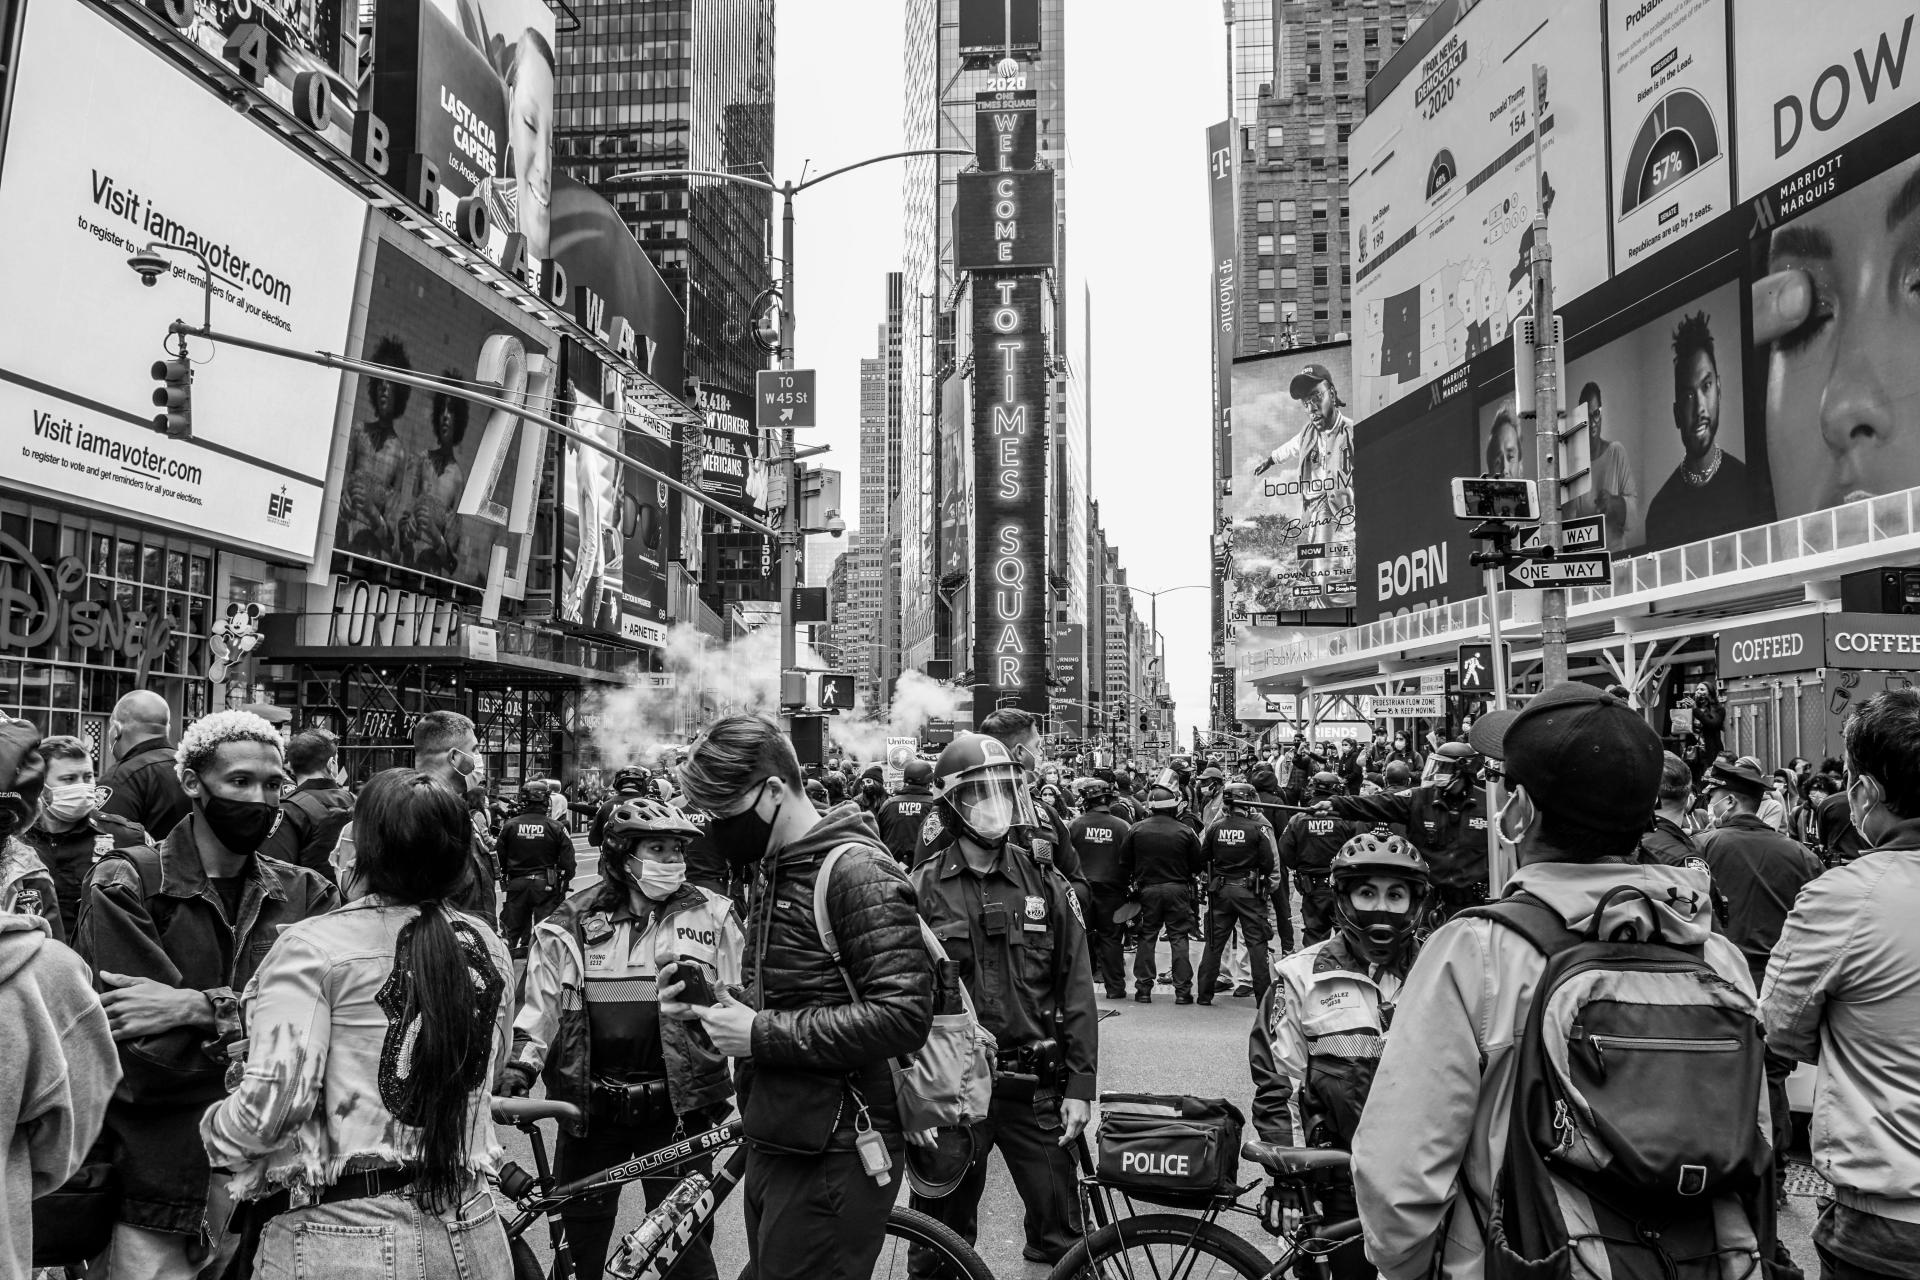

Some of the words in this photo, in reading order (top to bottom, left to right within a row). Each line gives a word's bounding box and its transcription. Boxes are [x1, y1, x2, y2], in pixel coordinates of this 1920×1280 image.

[1426, 53, 1439, 76] FOX
[1439, 33, 1458, 63] NEWS
[987, 77, 1027, 92] 2020
[1417, 45, 1464, 103] DEMOCRACY
[1637, 86, 1654, 103] Biden
[1653, 80, 1660, 91] is
[1659, 75, 1666, 87] in
[1666, 66, 1676, 81] the
[1676, 54, 1694, 74] Lead.
[976, 101, 1001, 110] TIMES
[1002, 100, 1037, 109] SQUARE
[996, 92, 1015, 101] ONE
[1428, 77, 1454, 121] 2020
[1489, 98, 1508, 122] Donald
[1507, 85, 1526, 106] Trump
[441, 84, 496, 154] LASTACIA
[1509, 110, 1526, 137] 154
[448, 152, 460, 170] Los
[453, 124, 496, 177] CAPERS
[1652, 150, 1683, 186] 57%
[1780, 154, 1843, 200] MARRIOTT
[993, 113, 1018, 262] WELCOME
[1780, 177, 1836, 217] MARQUIS
[78, 215, 88, 230] to
[90, 223, 125, 247] register
[125, 239, 135, 254] to
[92, 168, 140, 225] Visit
[144, 199, 292, 306] iamavoter.com
[1372, 229, 1384, 251] 199
[1628, 233, 1662, 259] Republicans
[1661, 227, 1672, 239] are
[1672, 221, 1680, 235] up
[1680, 216, 1689, 229] by
[1688, 211, 1694, 223] 2
[1694, 203, 1713, 220] seats.
[172, 264, 186, 280] get
[226, 289, 236, 304] for
[236, 296, 245, 309] all
[244, 303, 261, 319] your
[261, 305, 292, 333] elections.
[994, 280, 1018, 332] TO
[779, 376, 794, 389] TO
[1442, 364, 1471, 388] MARRIOTT
[765, 392, 776, 405] W
[777, 392, 793, 404] 45
[795, 391, 808, 404] St
[1442, 378, 1468, 400] MARQUIS
[993, 342, 1026, 500] TIMES
[33, 409, 73, 446] Visit
[76, 424, 203, 486] iamavoter.com
[22, 446, 31, 457] to
[31, 449, 60, 467] register
[61, 457, 69, 468] to
[70, 460, 86, 473] vote
[86, 466, 100, 477] and
[100, 470, 112, 482] get
[112, 472, 144, 490] reminders
[145, 481, 154, 492] for
[154, 485, 162, 495] all
[161, 488, 176, 500] your
[703, 453, 744, 478] MERICANS.
[1281, 518, 1333, 546] Burna
[1566, 527, 1593, 544] WAY
[1300, 547, 1322, 556] NOW
[1329, 545, 1349, 553] LIVE
[1277, 570, 1331, 580] DOWNLOAD
[1333, 568, 1353, 576] THE
[1377, 541, 1448, 601] BORN
[1519, 566, 1550, 579] ONE
[1564, 563, 1596, 577] WAY
[629, 622, 659, 642] ARNETTE
[1732, 632, 1804, 664] COFFEED
[478, 697, 491, 713] U.S.
[1372, 698, 1405, 706] PEDESTRIAN
[1405, 698, 1420, 706] FLOW
[1421, 698, 1436, 706] ZONE
[1400, 707, 1414, 715] KEEP
[888, 737, 916, 746] United
[684, 813, 705, 823] YPD
[898, 801, 922, 812] NYPD
[519, 823, 545, 835] NYPD
[1086, 827, 1113, 839] NYPD
[1219, 828, 1246, 840] NYPD
[1308, 819, 1335, 832] NYPD
[676, 927, 717, 947] POLICE
[1320, 991, 1349, 1006] GONZALEZ
[608, 1141, 692, 1182] POLICE
[701, 1127, 731, 1150] SRG
[1122, 1151, 1189, 1176] POLICE
